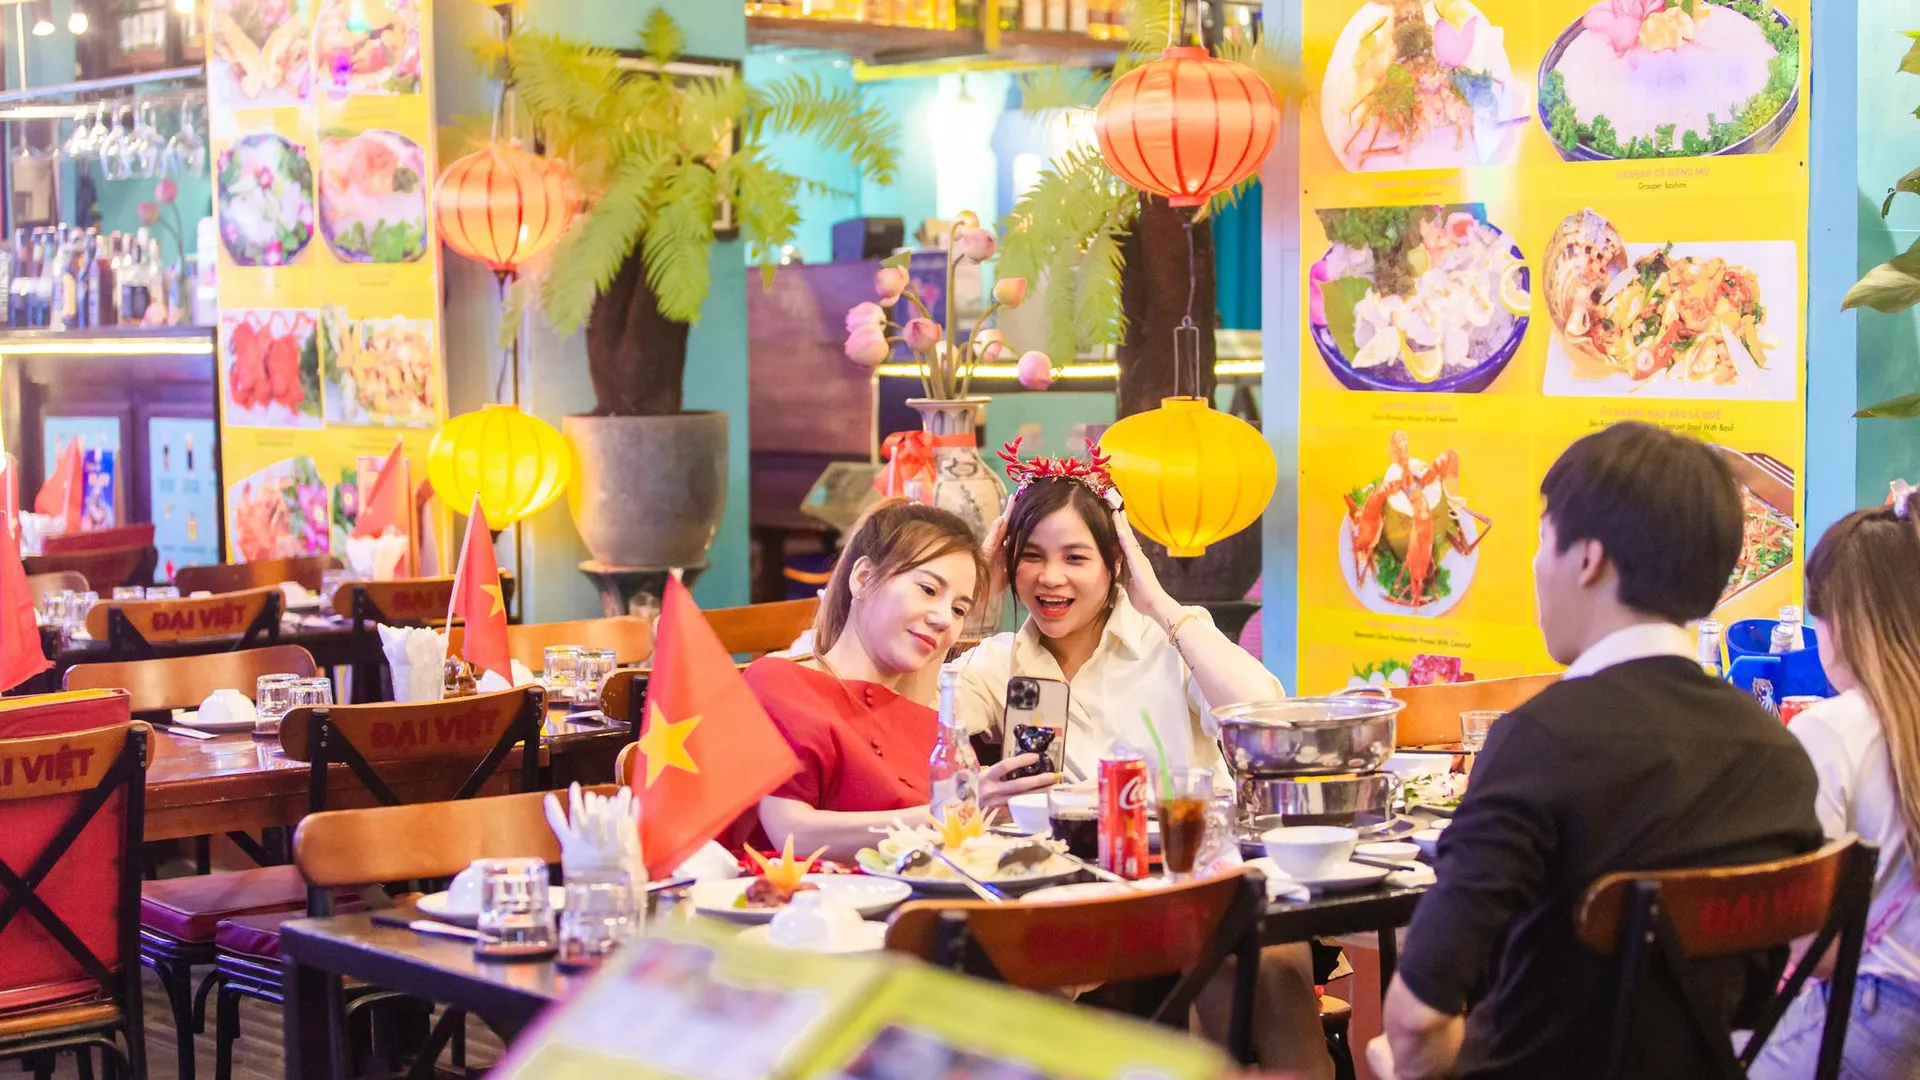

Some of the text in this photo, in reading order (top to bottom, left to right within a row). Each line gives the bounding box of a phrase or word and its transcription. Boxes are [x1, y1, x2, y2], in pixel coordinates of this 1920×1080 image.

[1638, 180, 1687, 191] Grouper Sashimi
[1703, 422, 1718, 432] With
[371, 706, 500, 751] ĐẠI VIỆT
[21, 744, 94, 786] VIỆT
